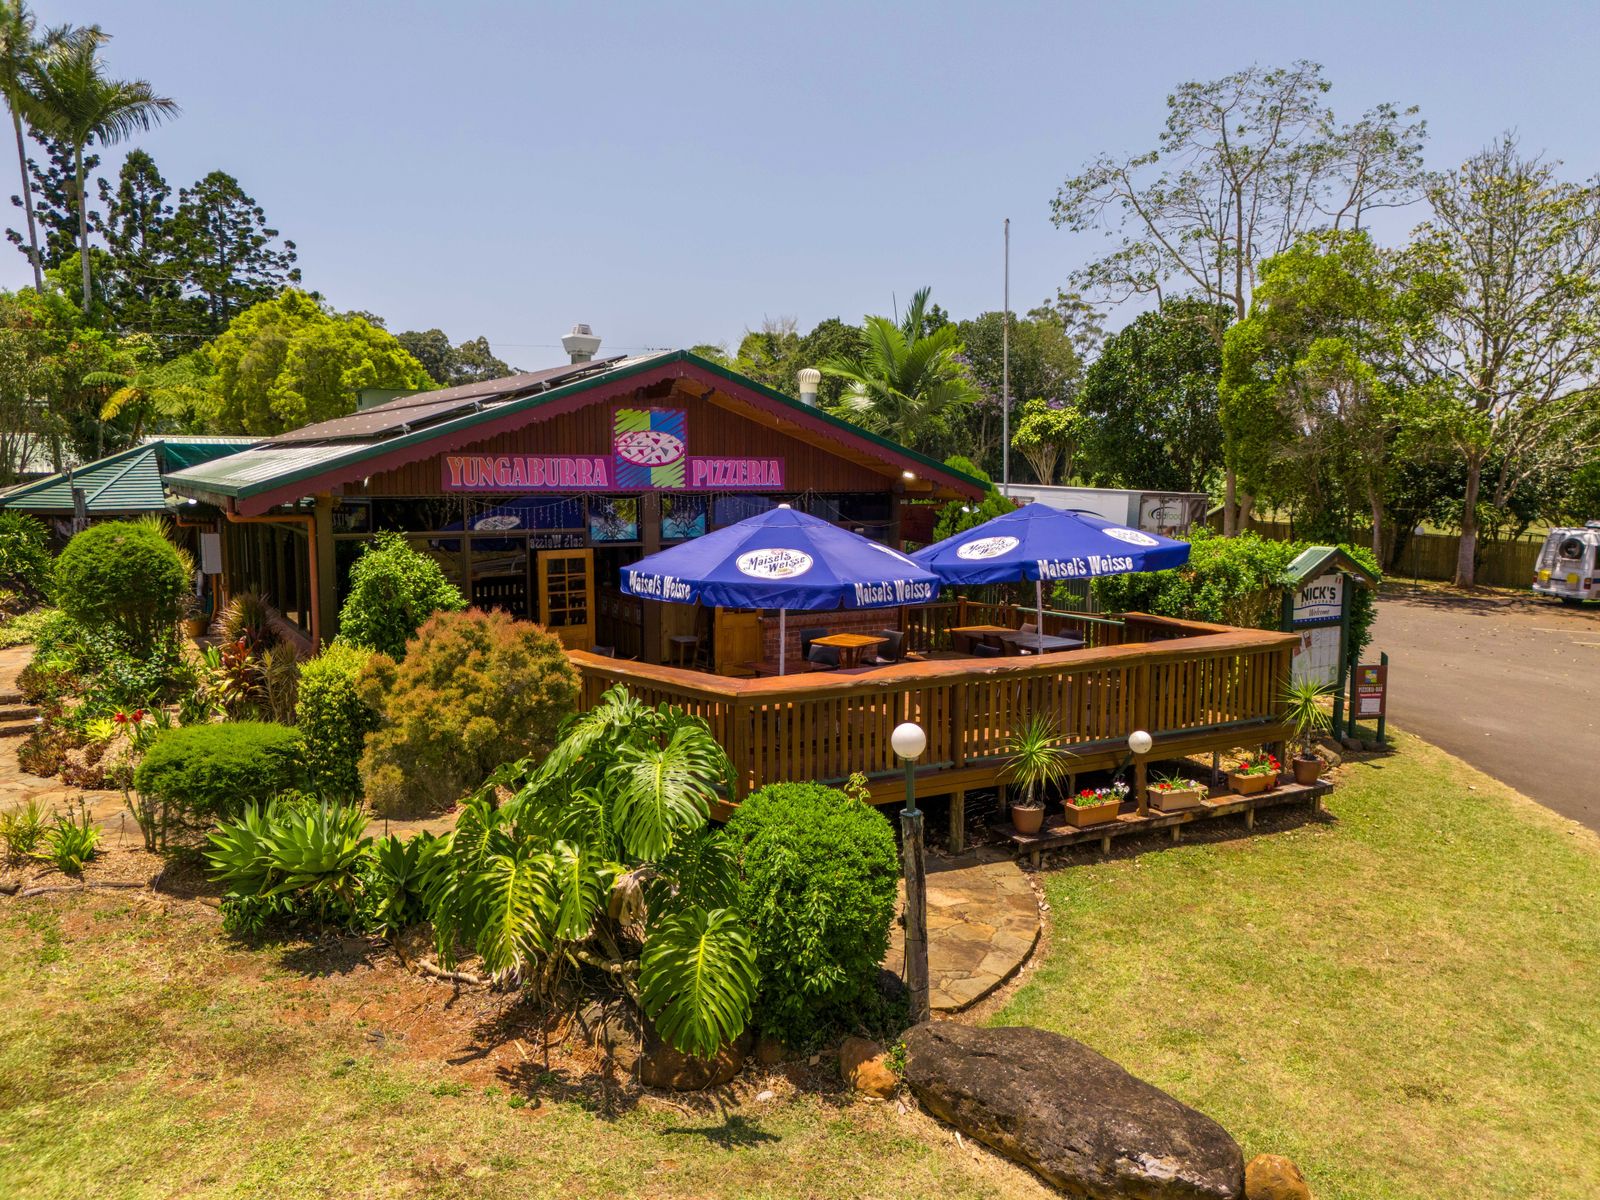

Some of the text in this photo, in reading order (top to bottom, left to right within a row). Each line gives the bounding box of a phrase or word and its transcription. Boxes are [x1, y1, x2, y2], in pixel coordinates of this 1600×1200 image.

[447, 457, 608, 487] YUNGABURRA
[692, 460, 781, 486] PIZZERIA
[749, 551, 792, 571] Maisel's
[768, 556, 806, 573] Weisse
[1037, 554, 1134, 580] Maisel's Weisse
[629, 570, 691, 600] Maisel's Weisse
[854, 579, 932, 606] Maisel's Weisse
[1301, 586, 1336, 602] NICK'S
